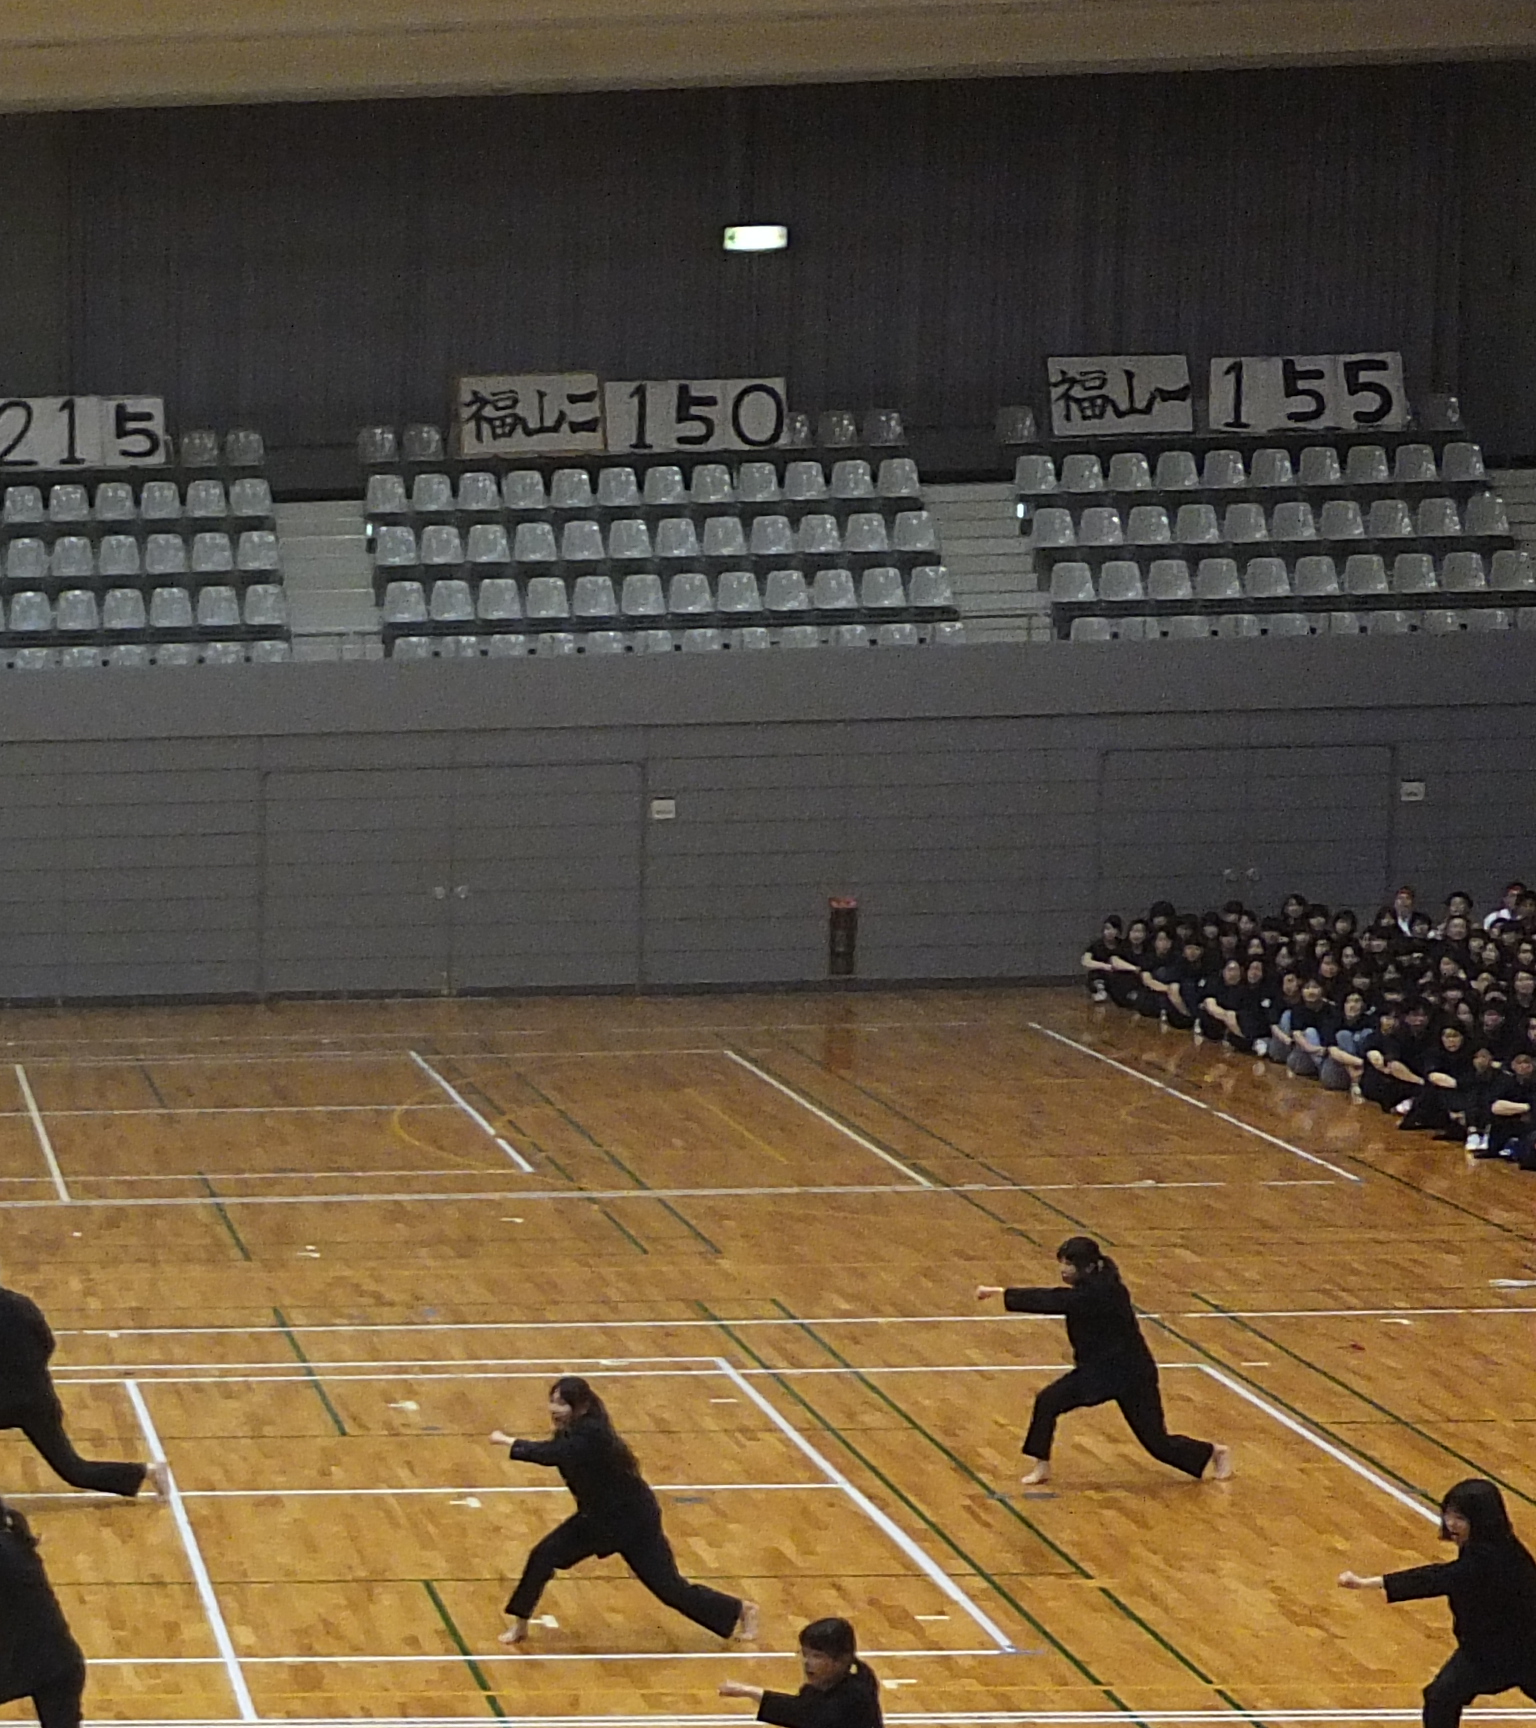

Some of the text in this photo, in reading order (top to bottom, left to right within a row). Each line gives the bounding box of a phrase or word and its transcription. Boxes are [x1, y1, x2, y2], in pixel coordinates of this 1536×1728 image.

[463, 383, 784, 449] 福山二 150
[1050, 359, 1394, 429] 福山一 155
